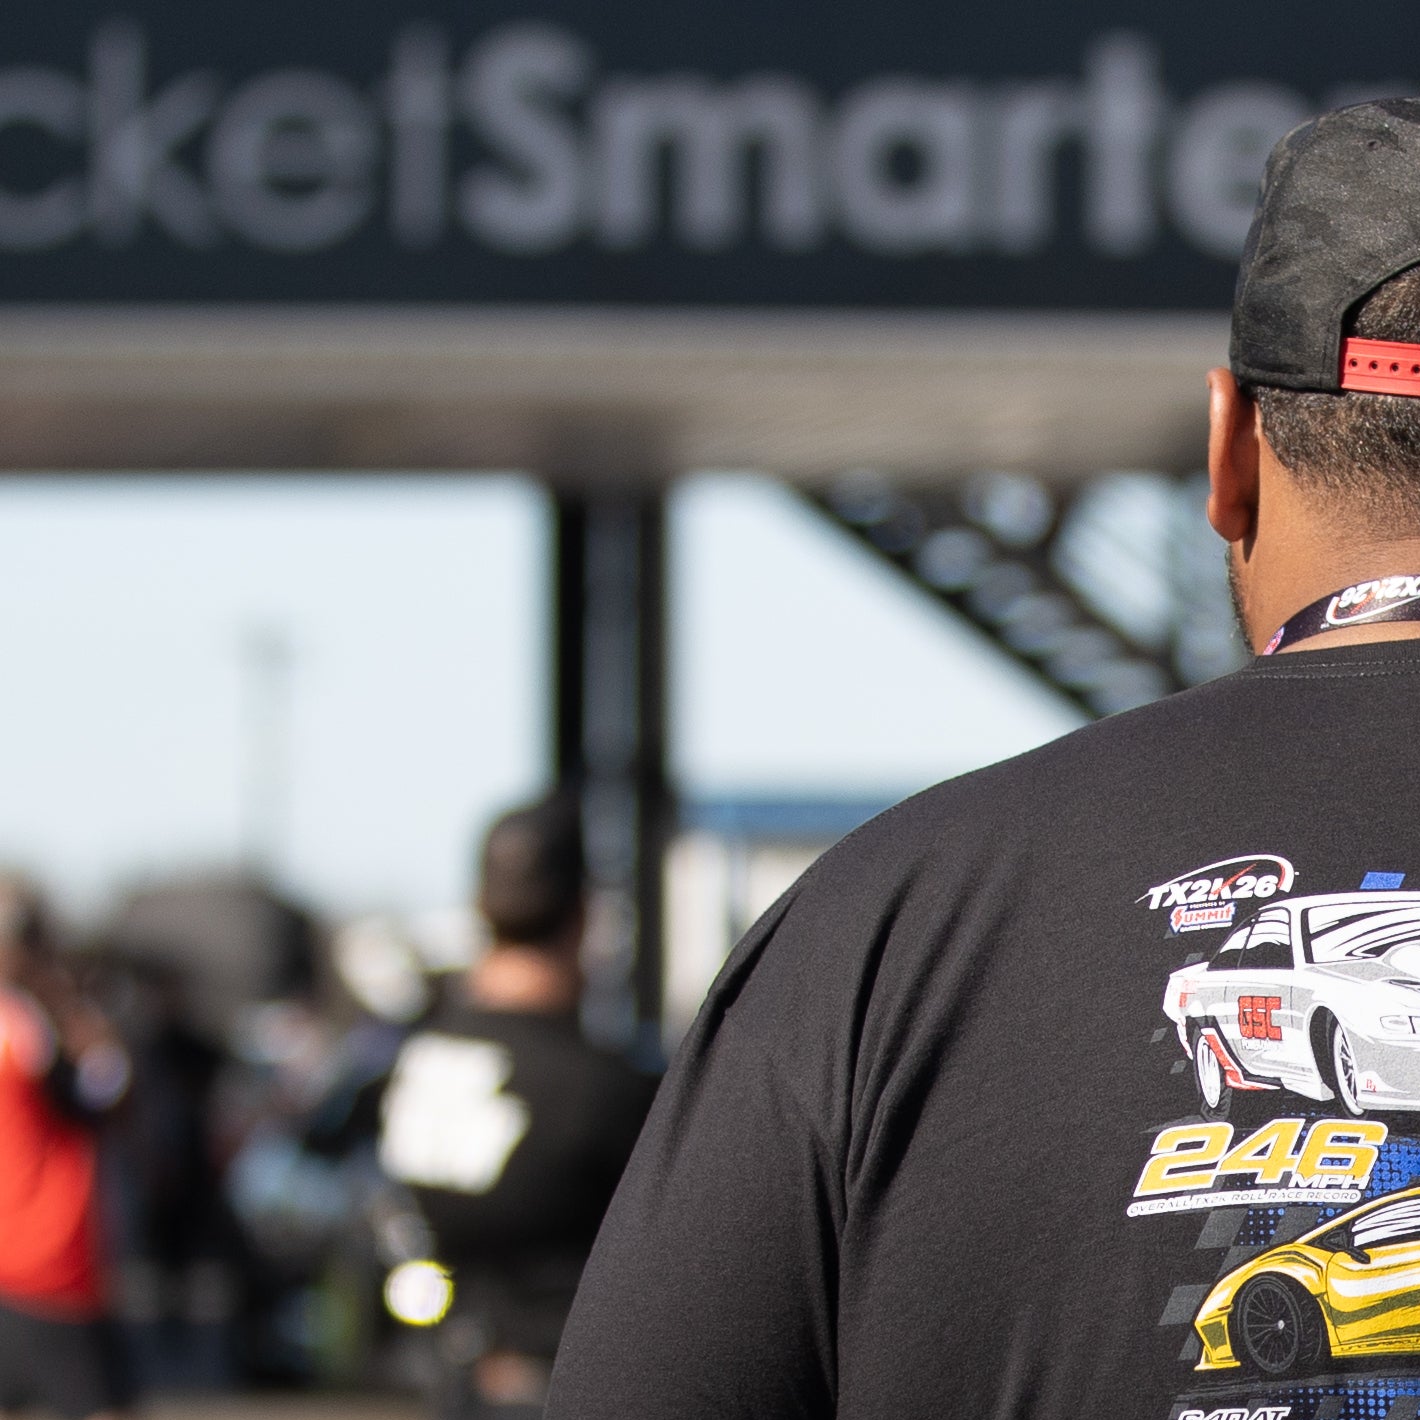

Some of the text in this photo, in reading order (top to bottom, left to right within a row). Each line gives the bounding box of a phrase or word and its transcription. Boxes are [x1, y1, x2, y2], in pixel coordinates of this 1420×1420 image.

[0, 20, 1415, 254] cketSmarte
[1149, 875, 1279, 909] TX2K26
[1238, 996, 1282, 1041] GSC
[1133, 1119, 1388, 1197] 246
[1289, 1173, 1370, 1190] MPH
[1130, 1198, 1190, 1215] OVERALL
[1231, 1192, 1263, 1202] ROLL
[1267, 1190, 1304, 1201] RACE
[1306, 1190, 1359, 1201] RECORD
